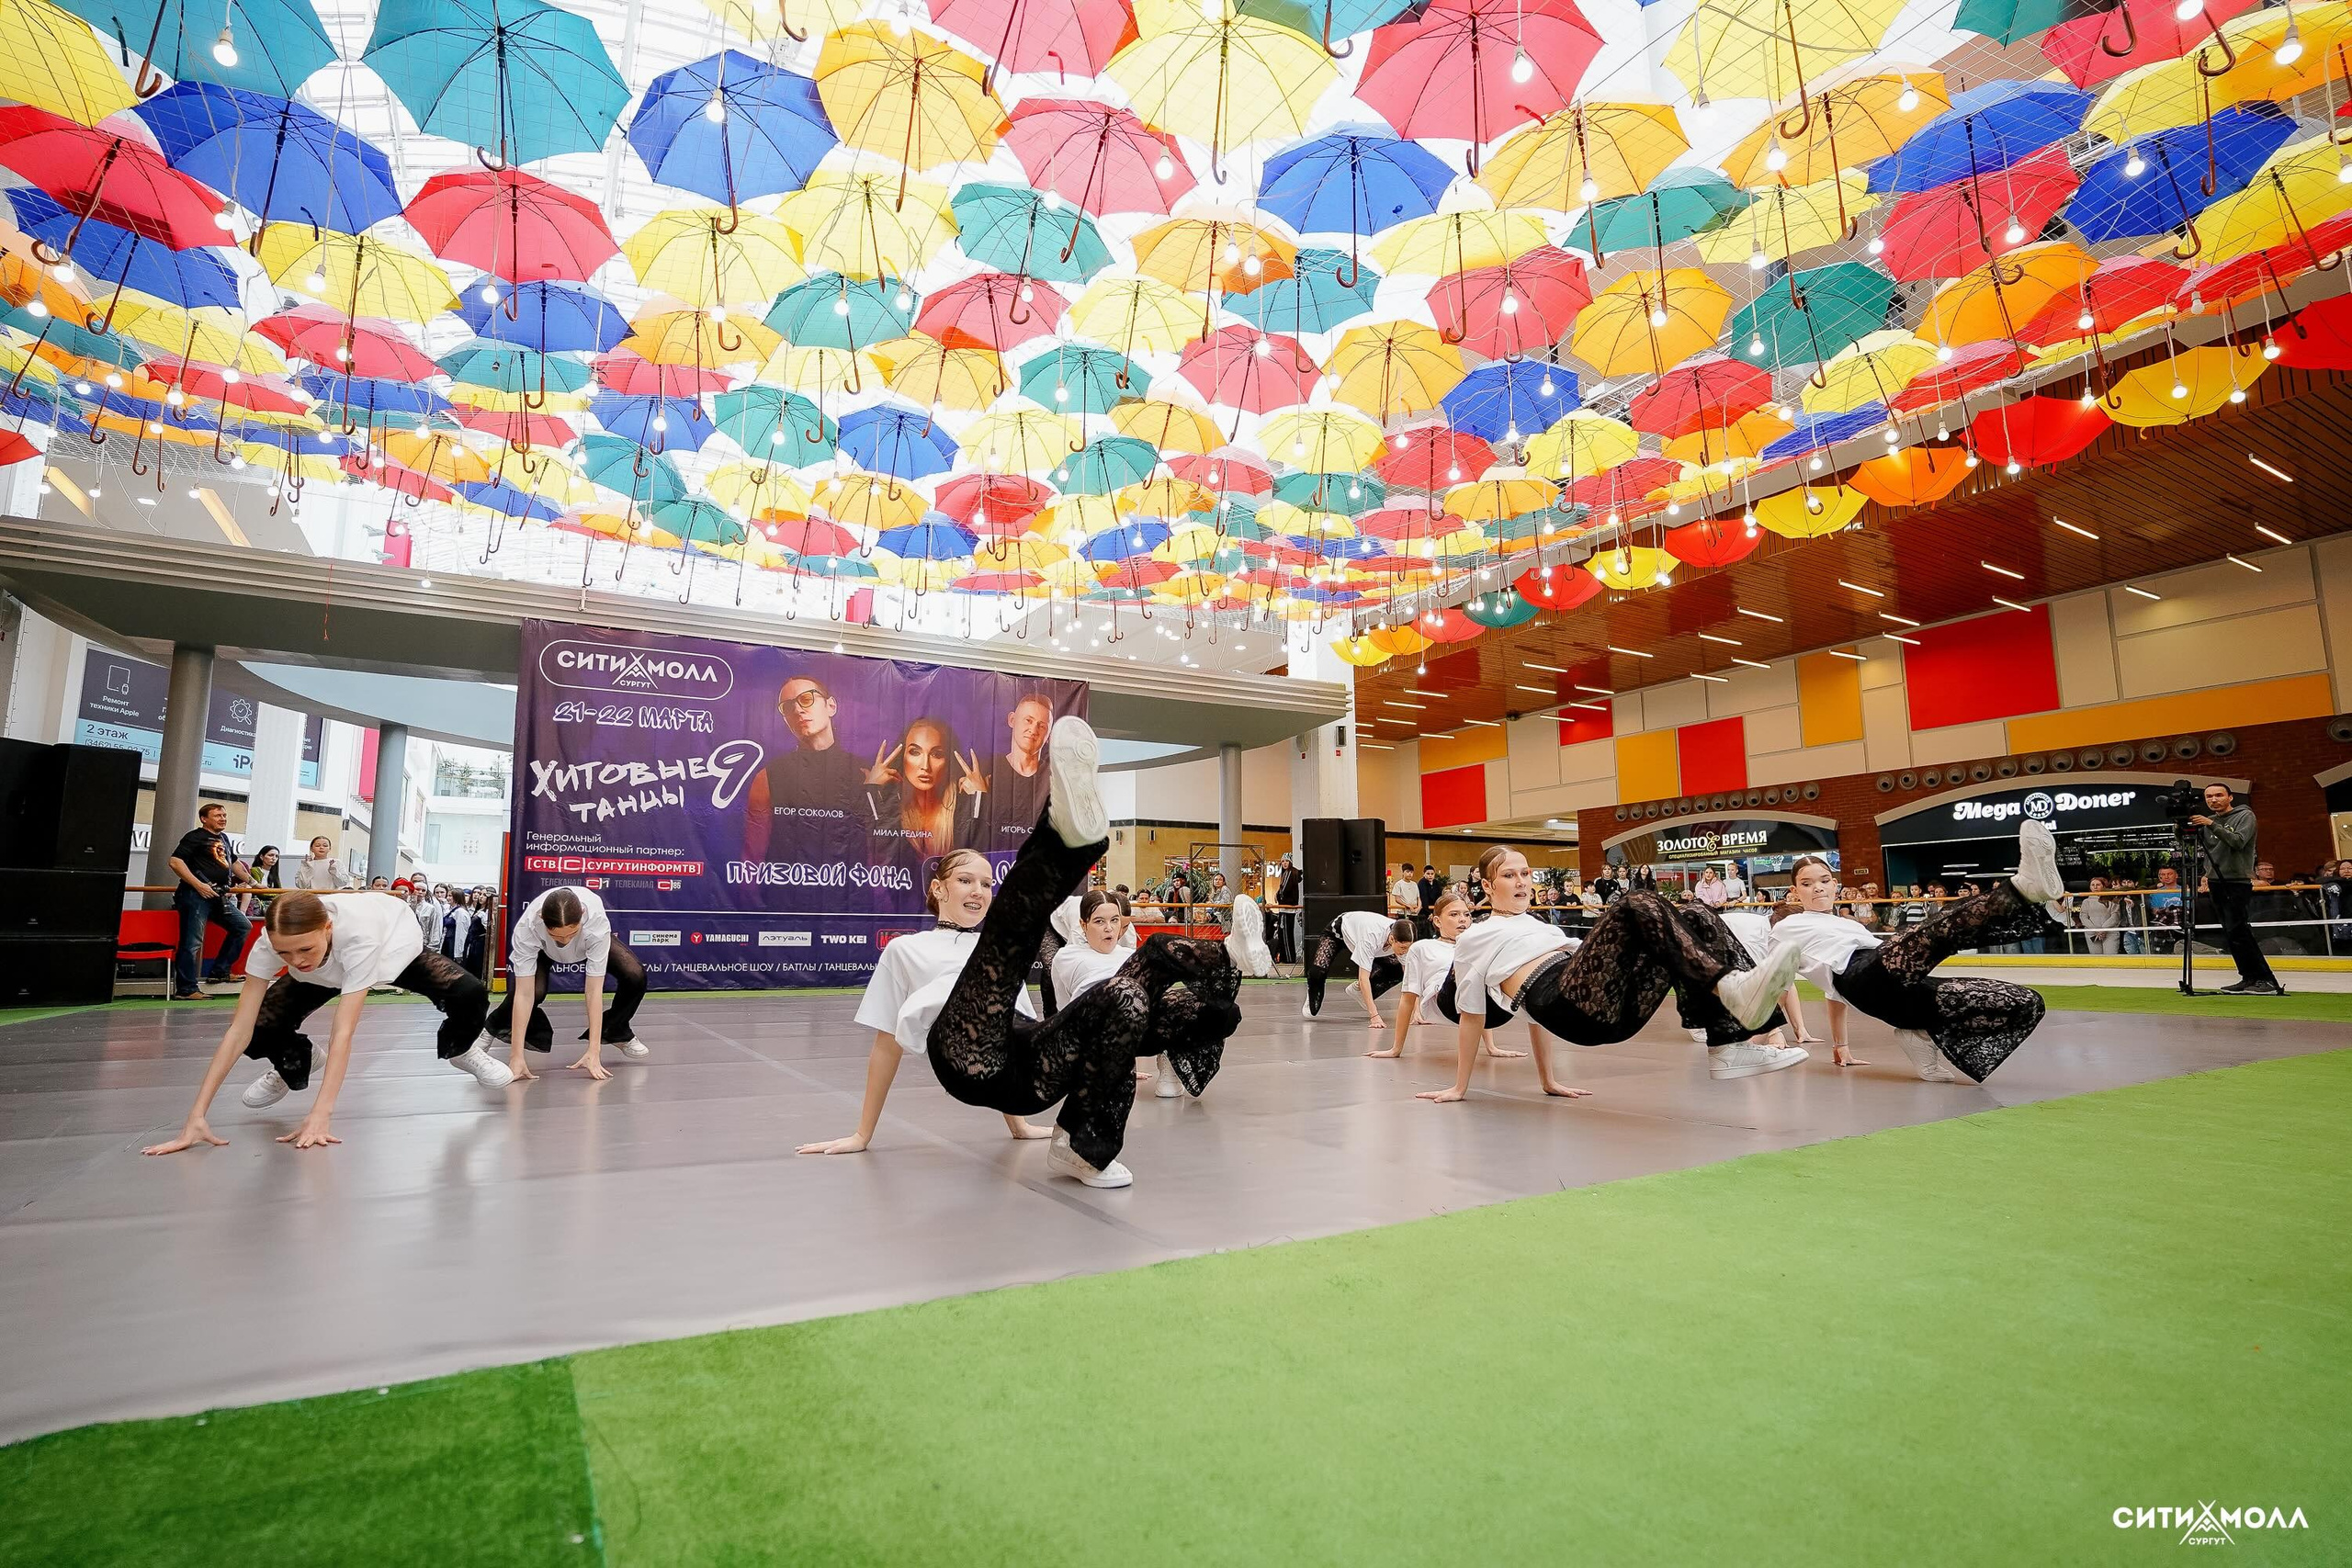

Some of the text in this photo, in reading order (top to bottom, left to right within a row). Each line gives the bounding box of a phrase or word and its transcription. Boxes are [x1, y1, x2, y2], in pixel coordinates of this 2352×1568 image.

[557, 650, 718, 682] СИТИ МОЛЛ
[619, 679, 651, 689] СУРГУТ
[102, 695, 130, 706] Ремонт
[90, 703, 140, 717] техники Apple
[553, 702, 714, 734] 21-22 МАРТА
[86, 724, 129, 740] 2 этаж
[220, 726, 256, 738] Диагностик
[569, 785, 684, 823] ТАНЦЫ
[1953, 802, 2021, 821] Mega
[2054, 792, 2136, 811] Doner
[775, 807, 844, 818] ЕГОР СОКОЛОВ
[873, 829, 933, 839] МИЛА РЕДИНА
[1001, 826, 1026, 834] ИГОРЬ
[526, 831, 602, 843] Генеральный
[1722, 830, 1768, 846] ВРЕМЯ
[526, 842, 684, 856] информационный партнер:
[727, 861, 846, 886] ПРИЗОВОЙ
[849, 863, 912, 890] ФОНД
[540, 878, 582, 886] ТЕЛЕКАНАЛ
[615, 879, 654, 888] ТЕЛЕКАНАЛ
[706, 934, 749, 942] YAMAGUCHI
[820, 935, 866, 944] TWO KEI
[672, 963, 747, 973] ТАНЦЕВАЛЬНОЕ
[750, 963, 775, 972] ШОУ
[782, 963, 817, 972] БАТТЛЫ
